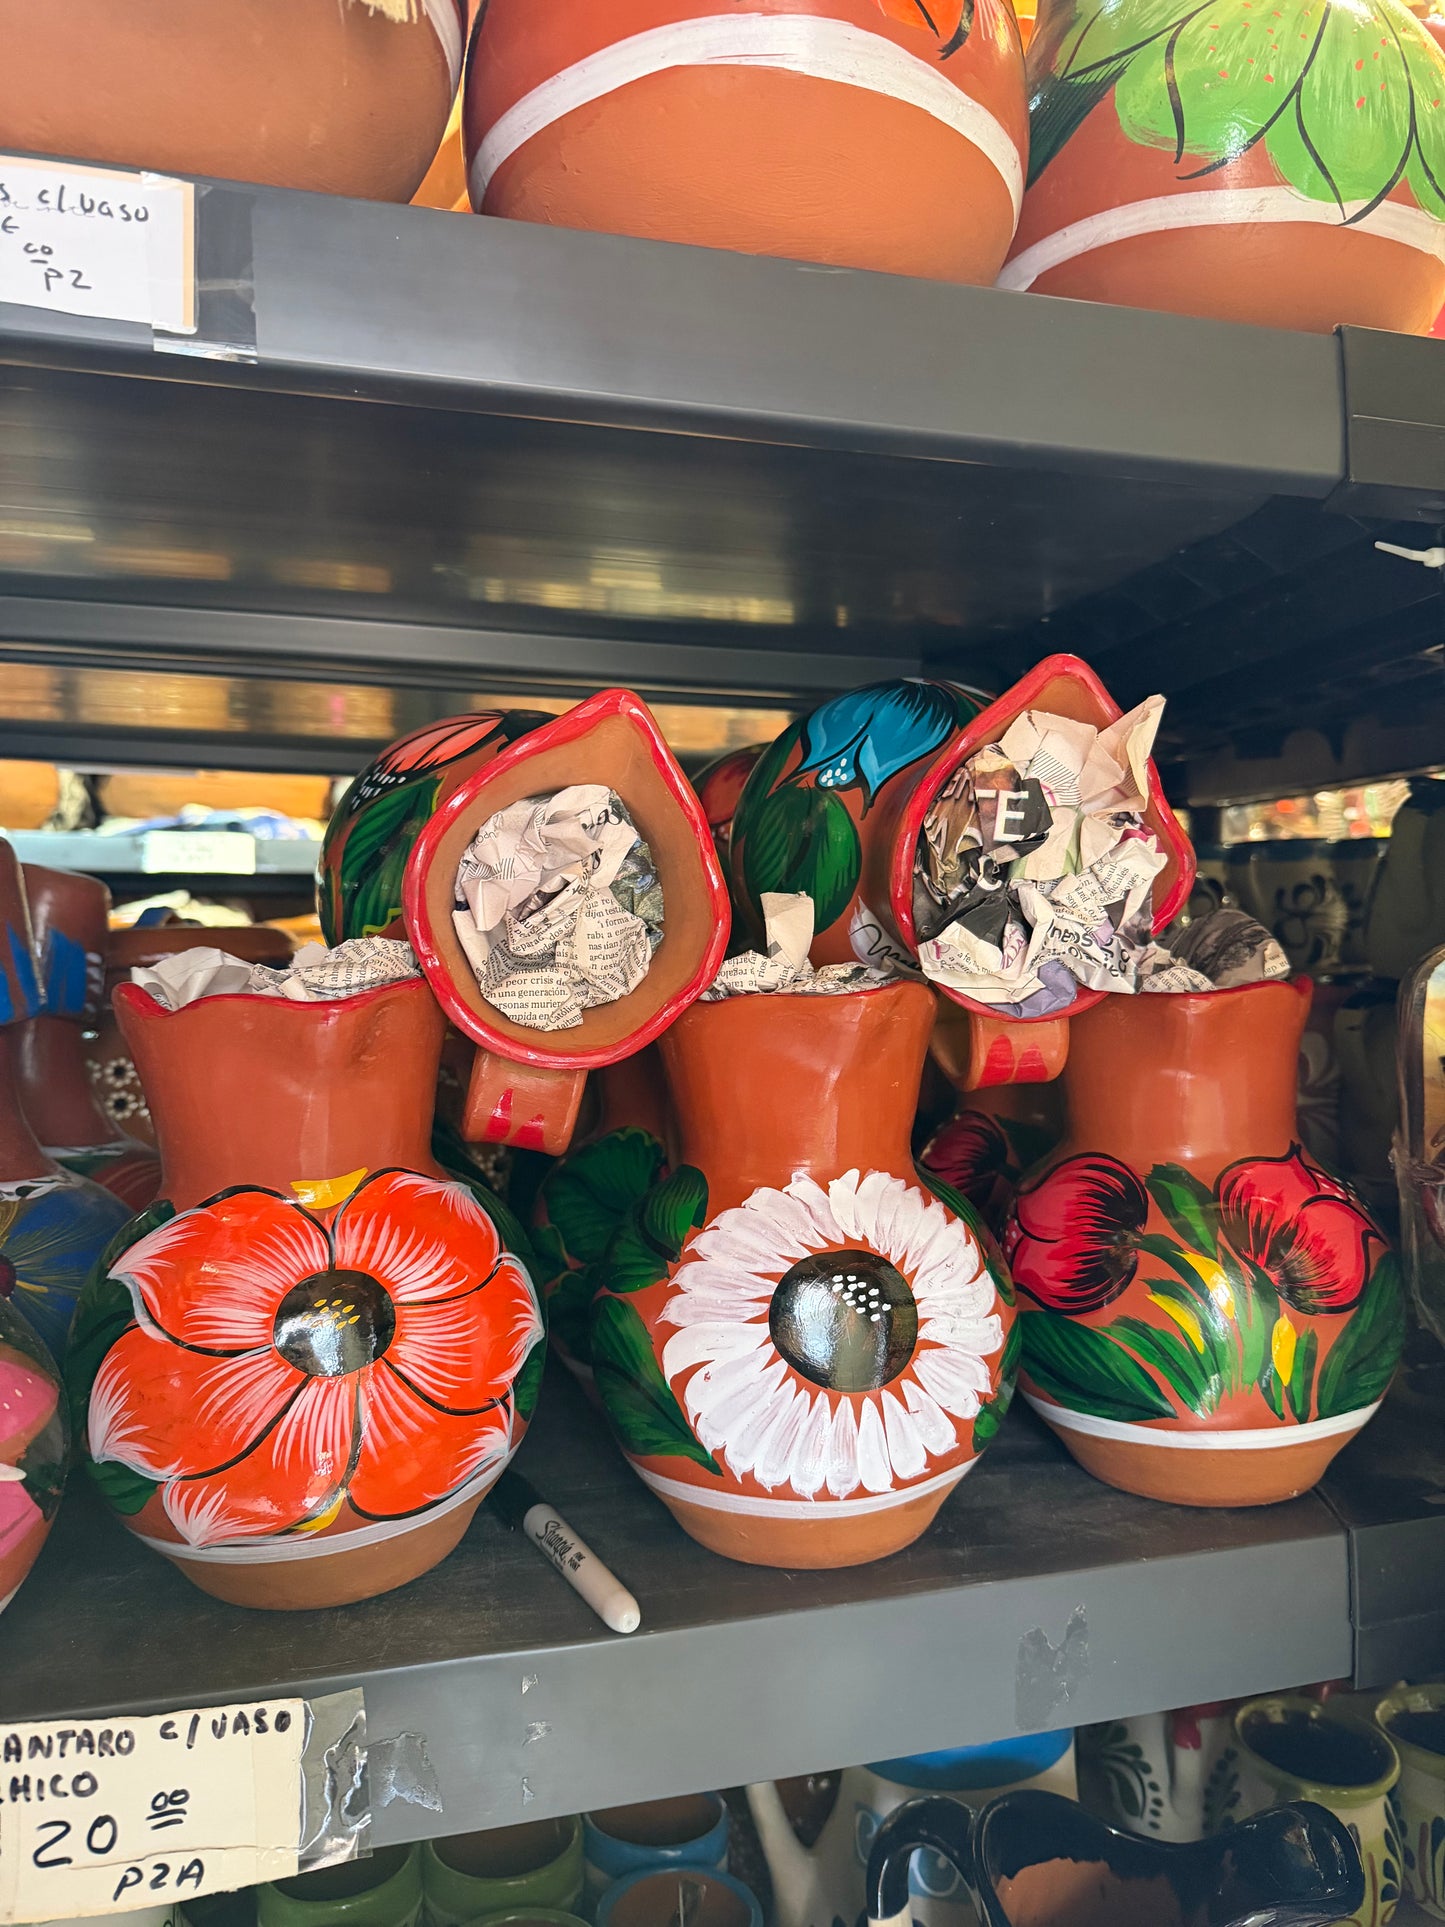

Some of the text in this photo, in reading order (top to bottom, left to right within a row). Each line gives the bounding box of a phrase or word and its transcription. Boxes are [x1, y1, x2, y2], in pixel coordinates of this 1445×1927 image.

[605, 915, 629, 929] forma
[498, 990, 516, 998] una
[518, 986, 568, 998] generación.
[505, 977, 528, 988] peor
[530, 975, 554, 985] crisis
[3, 1728, 136, 1763] ANTARO
[0, 1770, 98, 1803] HICO
[32, 1788, 190, 1868] 20 00
